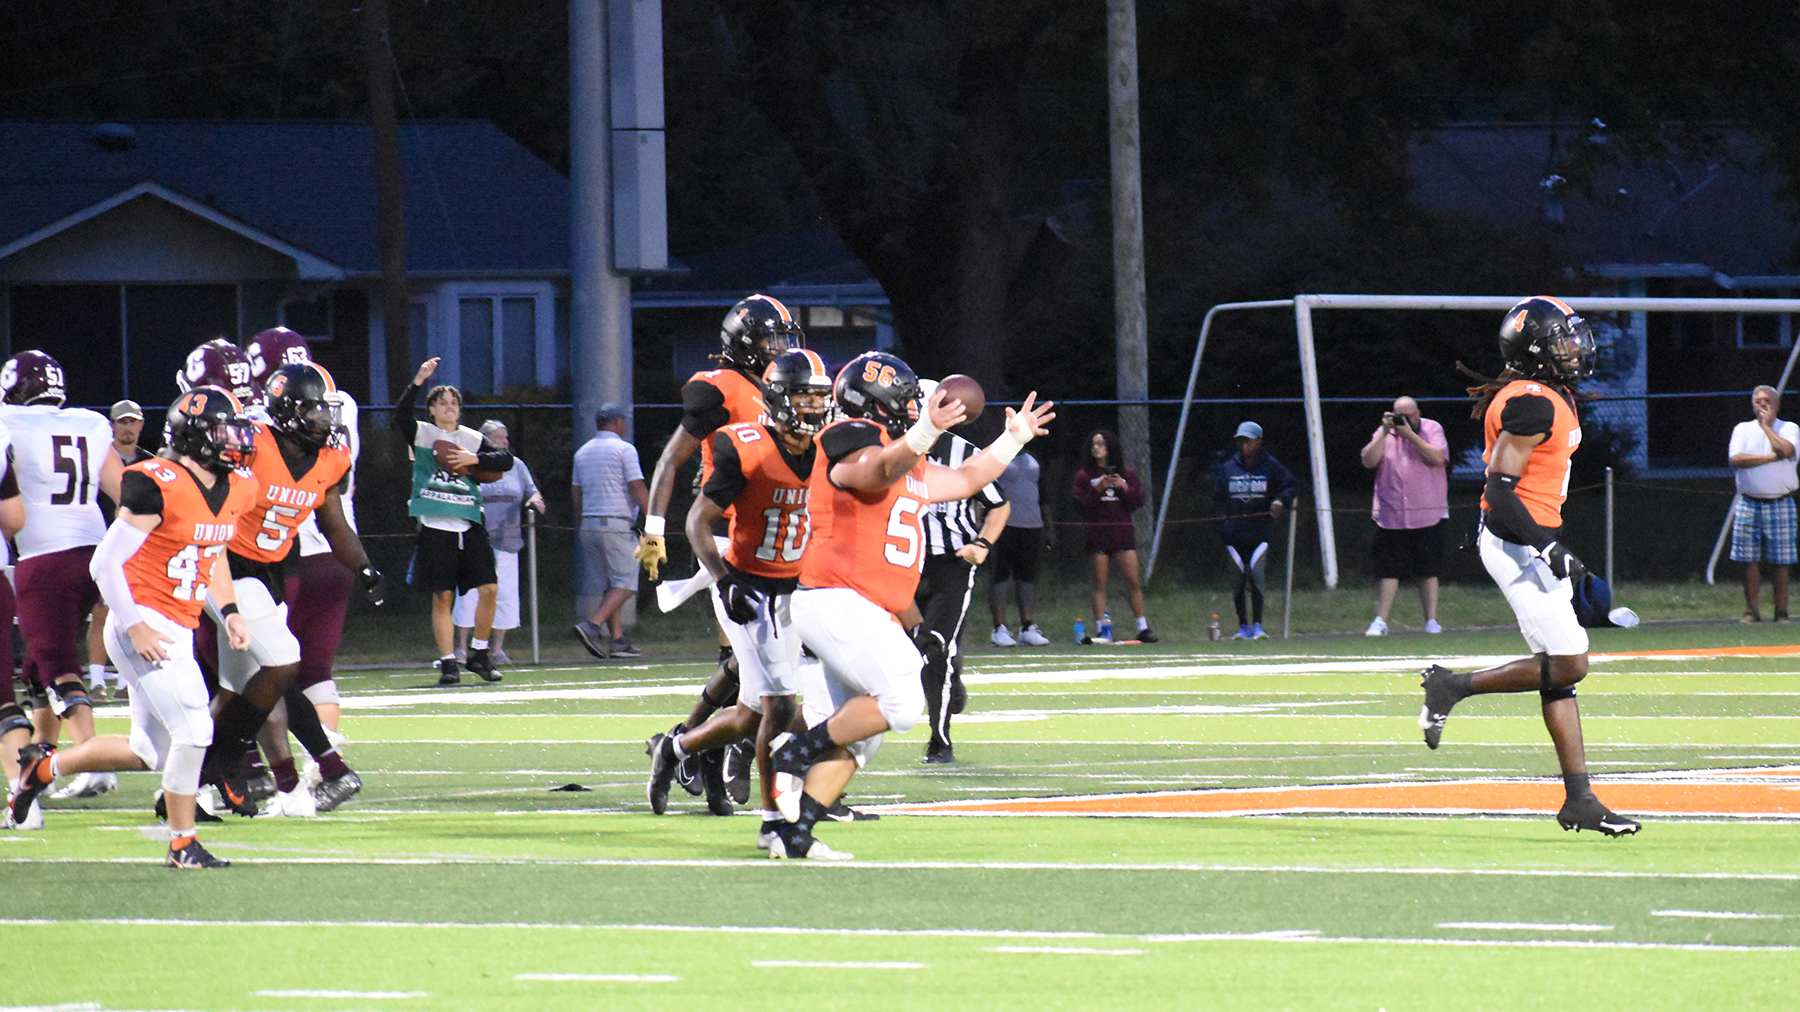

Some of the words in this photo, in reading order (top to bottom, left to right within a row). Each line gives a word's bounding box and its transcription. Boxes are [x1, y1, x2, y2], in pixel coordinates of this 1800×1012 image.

[1513, 309, 1529, 332] 4
[45, 364, 64, 387] 51
[227, 362, 250, 385] 57
[862, 360, 897, 388] 56
[51, 435, 90, 505] 51
[265, 484, 318, 507] UNION
[193, 523, 235, 541] UNION
[255, 505, 301, 551] 5
[755, 507, 812, 562] 10
